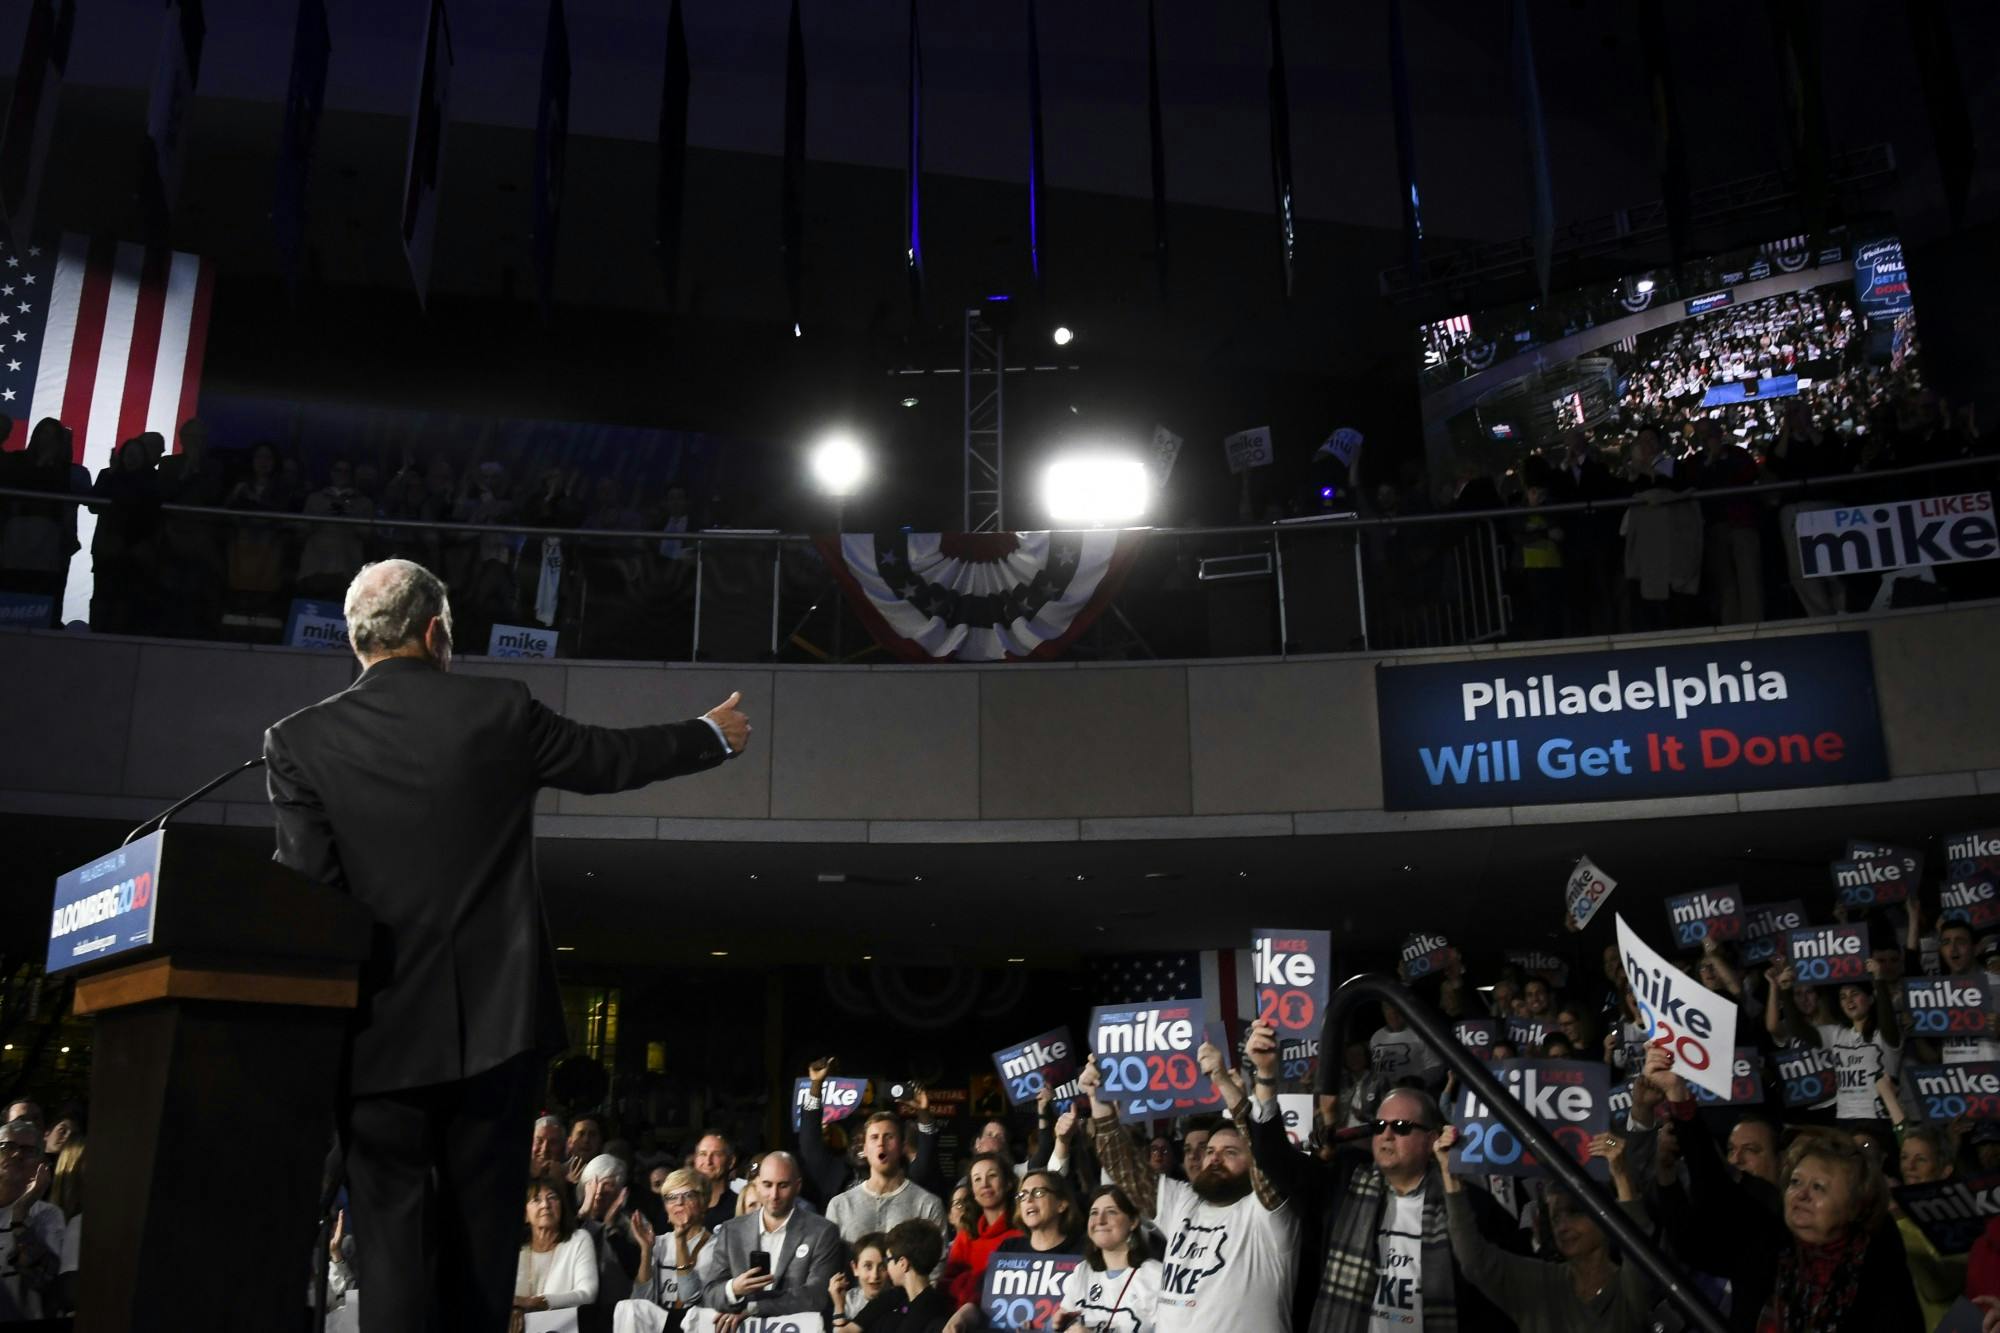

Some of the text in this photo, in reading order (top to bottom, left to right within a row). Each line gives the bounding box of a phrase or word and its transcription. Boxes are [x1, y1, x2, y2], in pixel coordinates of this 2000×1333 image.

[1876, 262, 1905, 273] WILL
[1835, 493, 1991, 528] PA LIKES
[1800, 505, 1996, 575] mike
[498, 631, 548, 651] mike
[1462, 661, 1789, 721] Philadelphia
[1419, 727, 1846, 786] Will Get It Done
[1949, 834, 2000, 860] mike
[1837, 862, 1902, 887] mike
[1673, 893, 1736, 925] mike
[1940, 881, 1995, 908] mike
[1679, 916, 1741, 945] 2020
[1793, 930, 1862, 960] mike
[1251, 938, 1316, 987] ike
[1402, 934, 1449, 962] mike
[1795, 954, 1865, 981] 2020
[1258, 989, 1315, 1030] 20
[1626, 951, 1713, 1039] mike
[1908, 981, 1982, 1009] mike
[1098, 1009, 1193, 1055] mike
[1456, 1024, 1490, 1047] ike
[1507, 1023, 1548, 1047] mik
[1912, 1009, 1985, 1032] 2020
[1282, 1039, 1320, 1061] mik
[1637, 1001, 1710, 1071] 020
[1002, 1040, 1068, 1080] mike
[1100, 1054, 1198, 1092] 2020
[1779, 1047, 1834, 1080] mik
[1786, 1074, 1836, 1100] 202
[1917, 1067, 2000, 1095] mike
[1461, 1122, 1592, 1168] 200
[1385, 1248, 1414, 1270] for
[991, 1260, 1067, 1296] mik
[1376, 1274, 1415, 1310] KE
